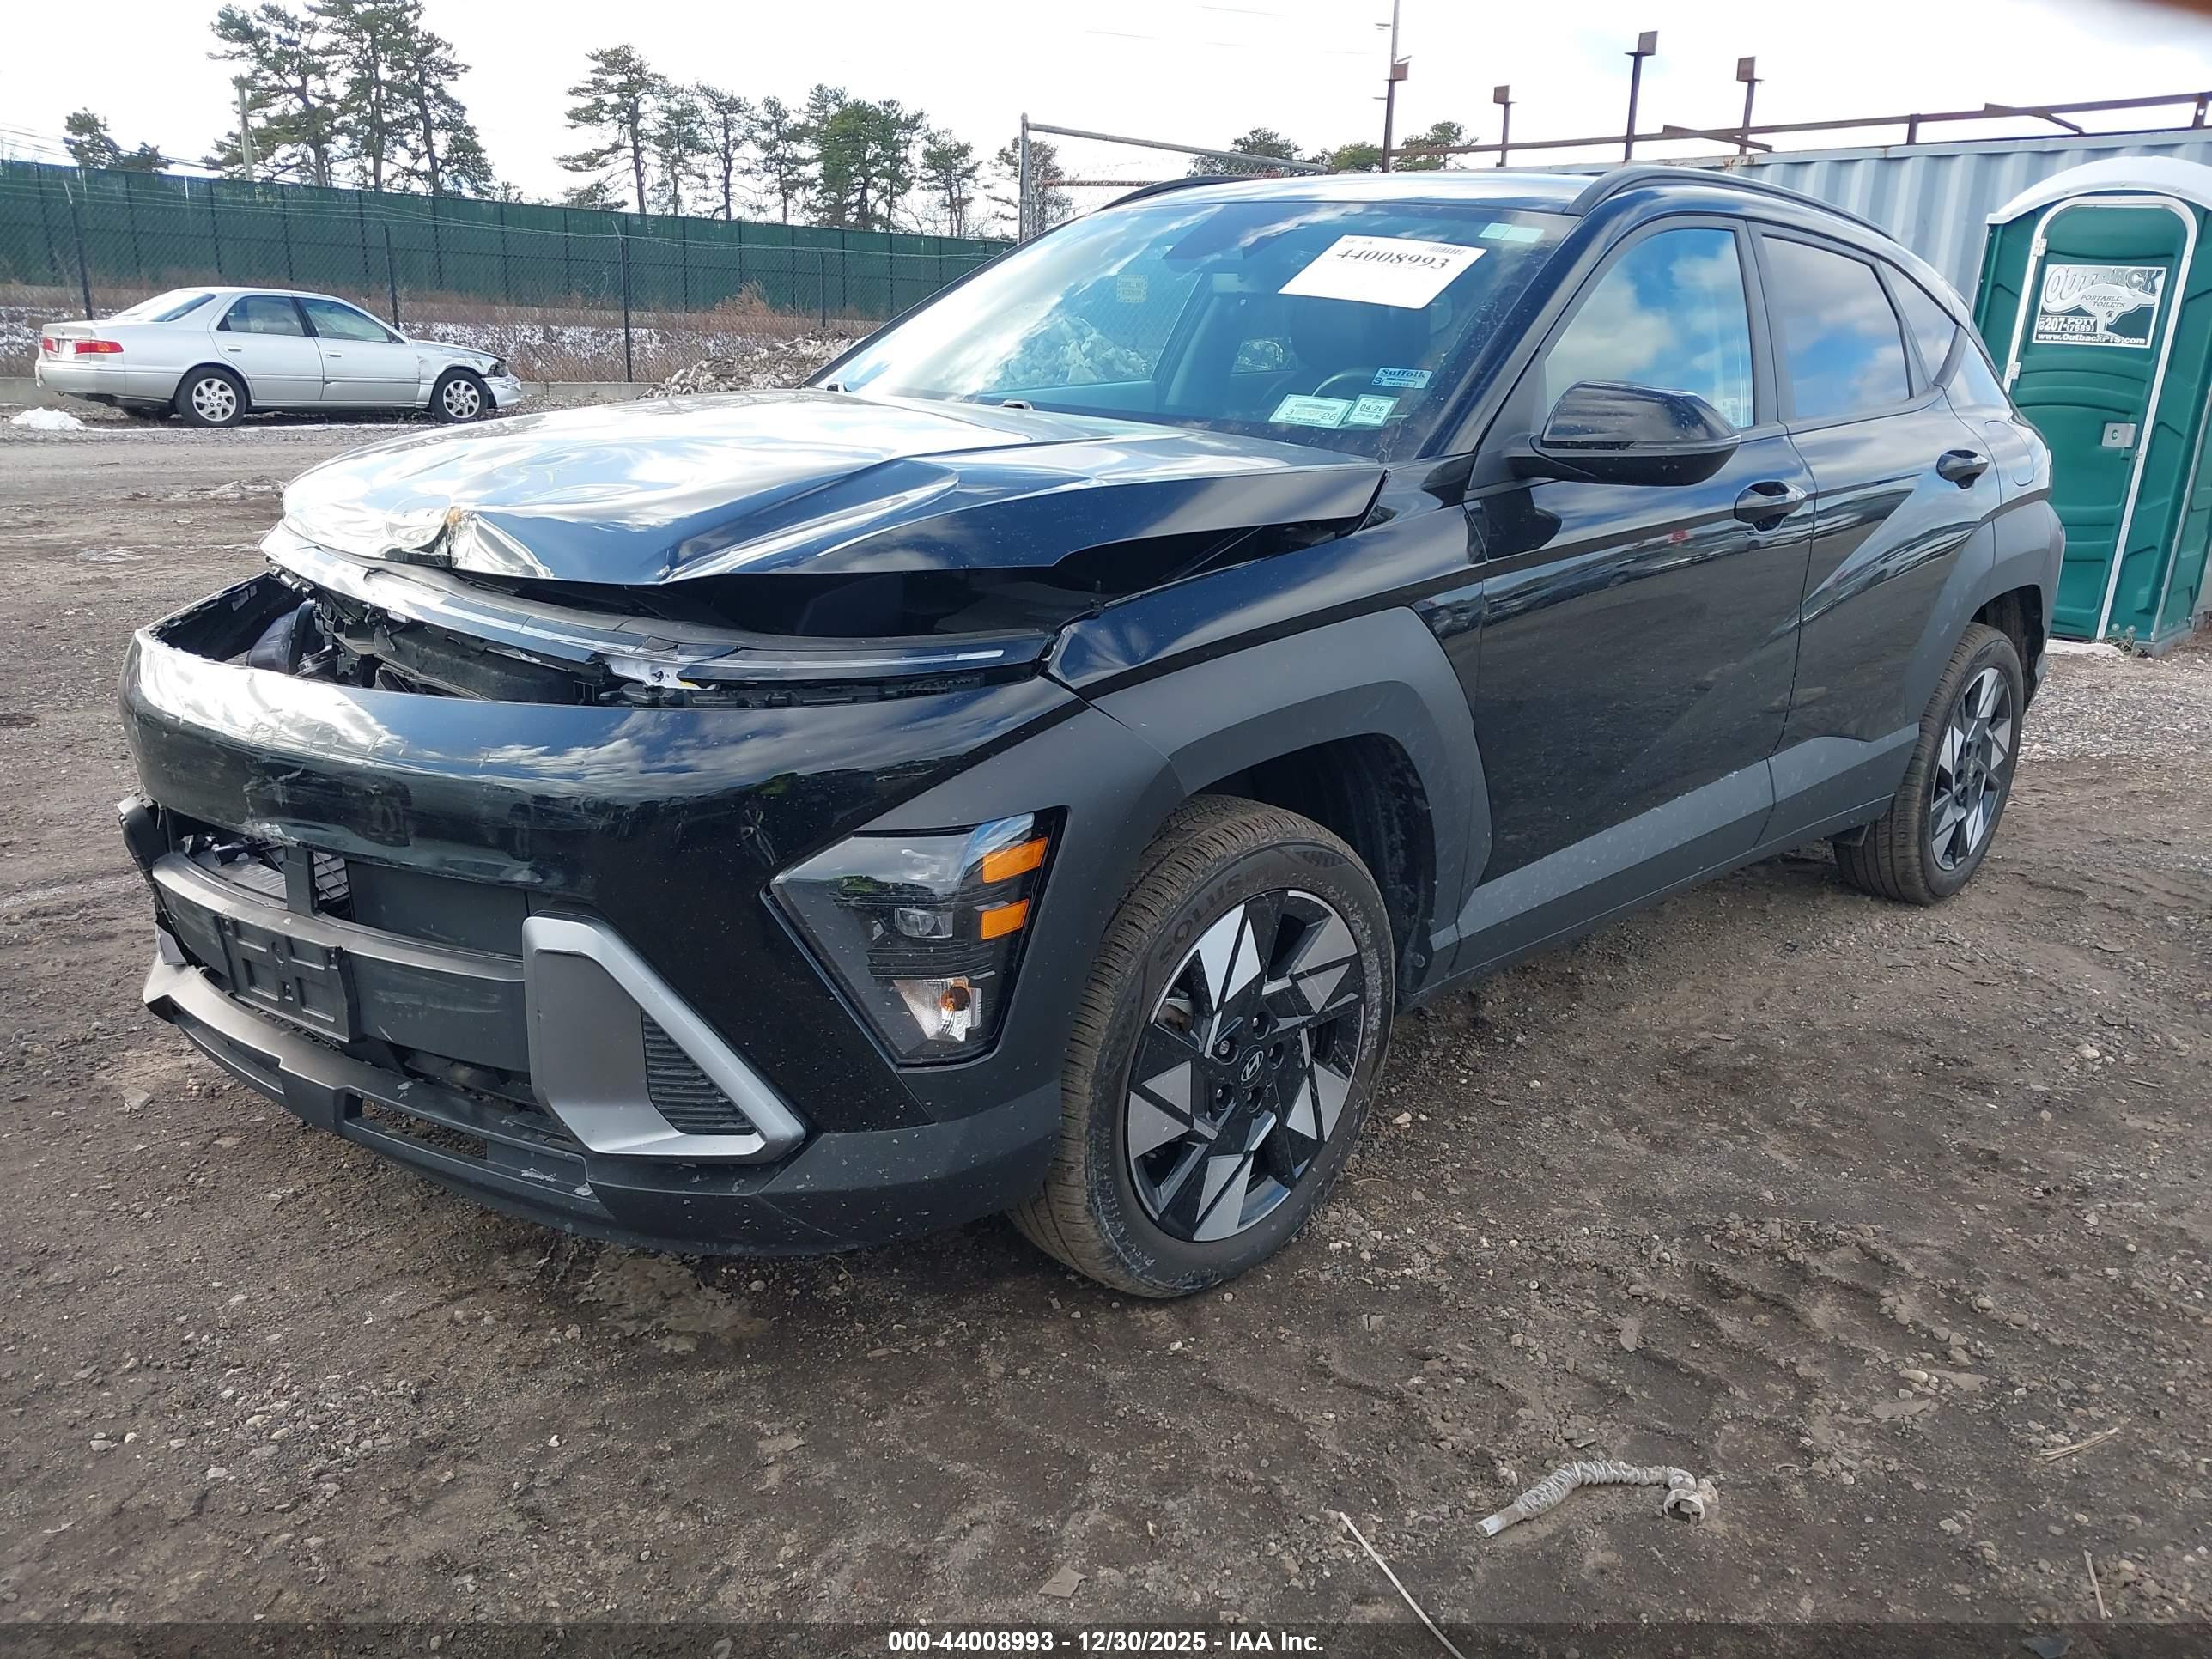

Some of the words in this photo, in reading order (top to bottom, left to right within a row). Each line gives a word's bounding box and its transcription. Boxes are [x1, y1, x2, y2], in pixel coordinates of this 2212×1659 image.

[1336, 248, 1450, 270] 44008993
[1380, 368, 1427, 379] Suffolk
[1159, 873, 1242, 964] SOLUS
